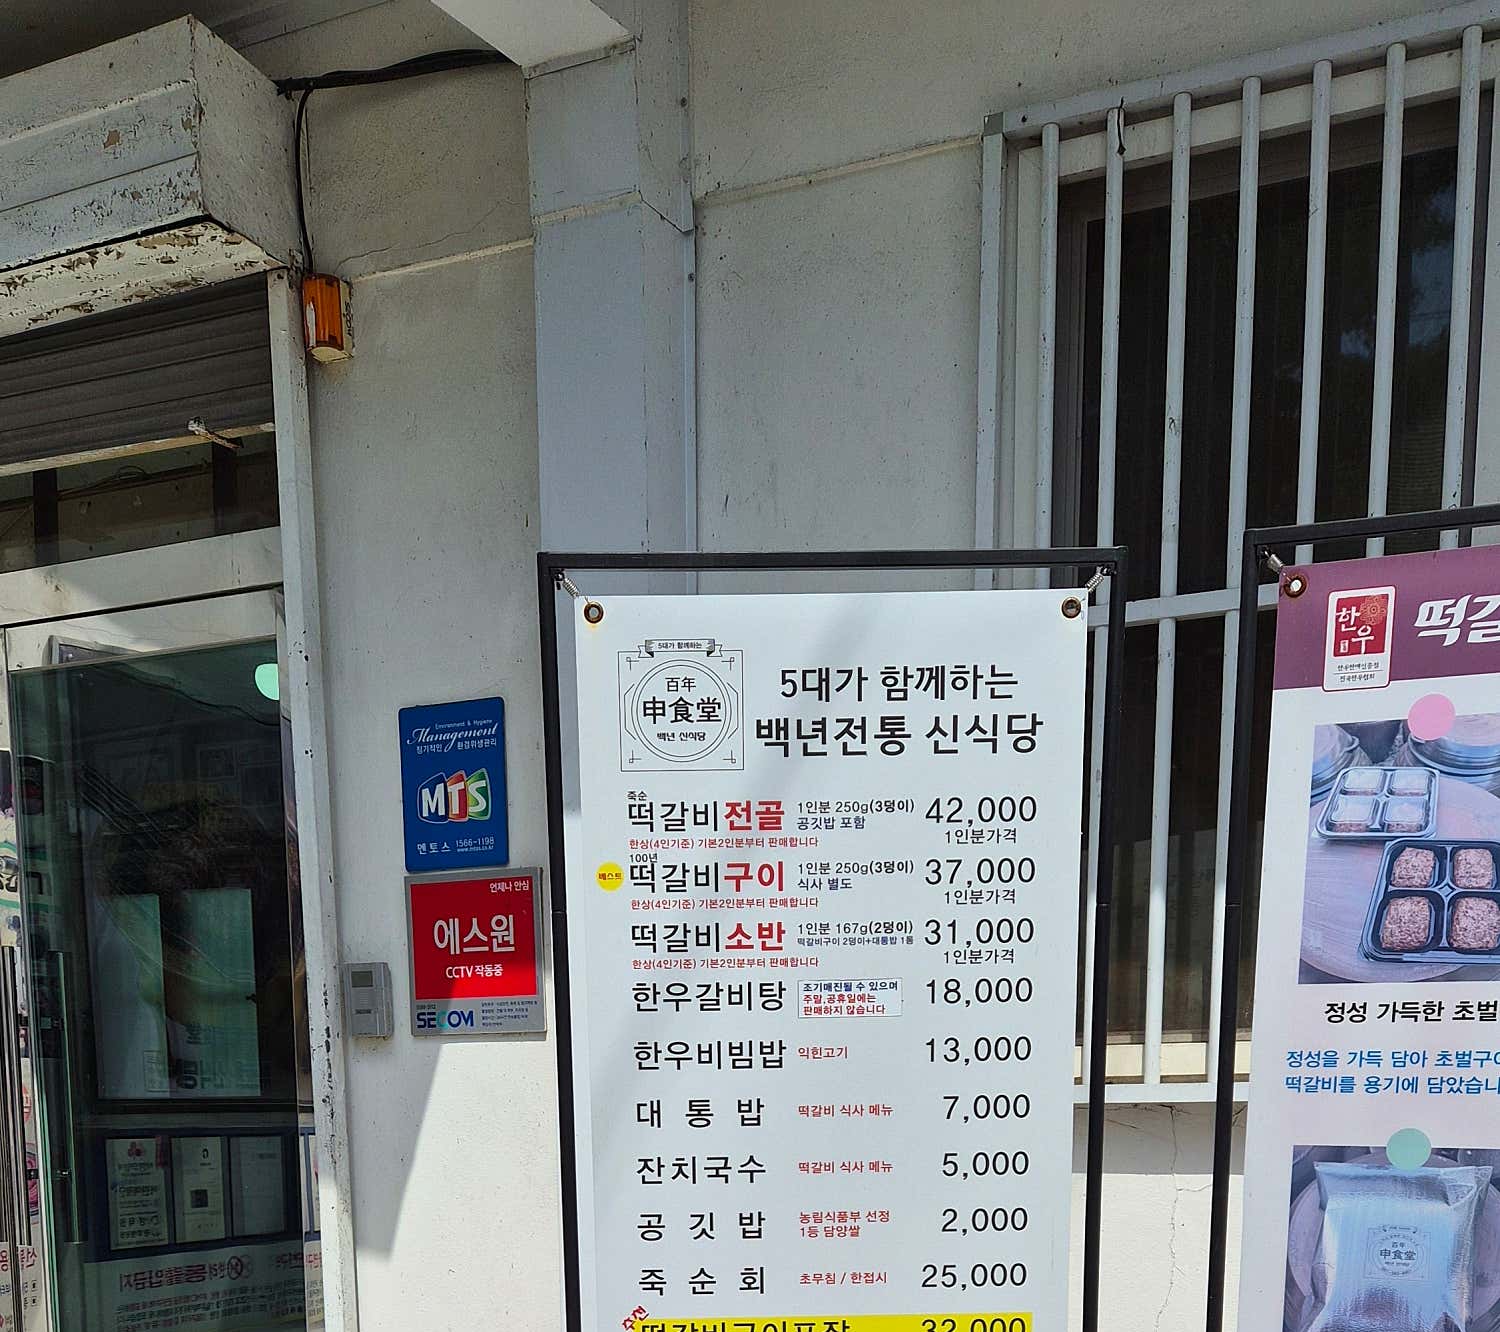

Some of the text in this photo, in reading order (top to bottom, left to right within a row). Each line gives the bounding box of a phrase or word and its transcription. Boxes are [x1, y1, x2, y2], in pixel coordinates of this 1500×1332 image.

[665, 677, 696, 692] 百年
[781, 665, 1018, 702] 5대가 함께하는
[643, 696, 721, 724] 申食堂
[407, 723, 498, 752] Management
[657, 733, 675, 741] 백년
[757, 713, 1043, 757] 백년전통 신식당
[421, 780, 489, 818] MTS
[628, 791, 646, 801] 죽순
[629, 798, 784, 832] 떡갈비전골
[798, 799, 914, 814] 1인분 250g(3덩이)
[926, 796, 1036, 827] 42,000
[797, 816, 865, 830] 공깃밥 포함
[630, 837, 818, 849] 한상(4인기준) 기본2인분부터 판매합니다
[946, 828, 1016, 844] 1인분가격
[630, 853, 658, 863] 100년
[630, 861, 783, 893] 떡갈비구이
[926, 858, 1035, 888] 37,000
[490, 880, 530, 892] 언제나 안심
[798, 878, 852, 891] 식사 별도
[434, 914, 515, 955] 에스원
[632, 922, 785, 953] 떡갈비소반
[837, 921, 912, 935] 167g(2덩이)
[925, 918, 1034, 948] 31,000
[446, 964, 503, 979] CCTV 작동중
[856, 982, 865, 991] 수
[869, 981, 897, 991] 있으며
[927, 978, 1032, 1007] 18,000
[632, 981, 786, 1012] 한우갈비탕
[417, 1010, 473, 1028] SECOM
[803, 1005, 885, 1015] 판매하지 않습니다
[1325, 1001, 1497, 1023] 정성 가득한 초벌
[634, 1040, 786, 1070] 한우비빔밥
[798, 1047, 847, 1059] 익힌고기
[926, 1037, 1031, 1065] 13,000
[1287, 1050, 1428, 1068] 정성을 가득 담아
[1286, 1076, 1356, 1093] 떡갈비를
[1364, 1076, 1418, 1093] 용기에
[799, 1104, 893, 1117] 떡갈비 식사 메뉴
[944, 1094, 1030, 1123] 7,000
[637, 1156, 765, 1184] 잔치국수
[943, 1151, 1028, 1180] 5,000
[800, 1211, 889, 1224] 농림식품부 선정
[942, 1208, 1027, 1236] 2,000
[800, 1225, 860, 1238] 1등 담양쌀
[800, 1272, 886, 1284] 초무침 한접시
[922, 1263, 1026, 1291] 25,000
